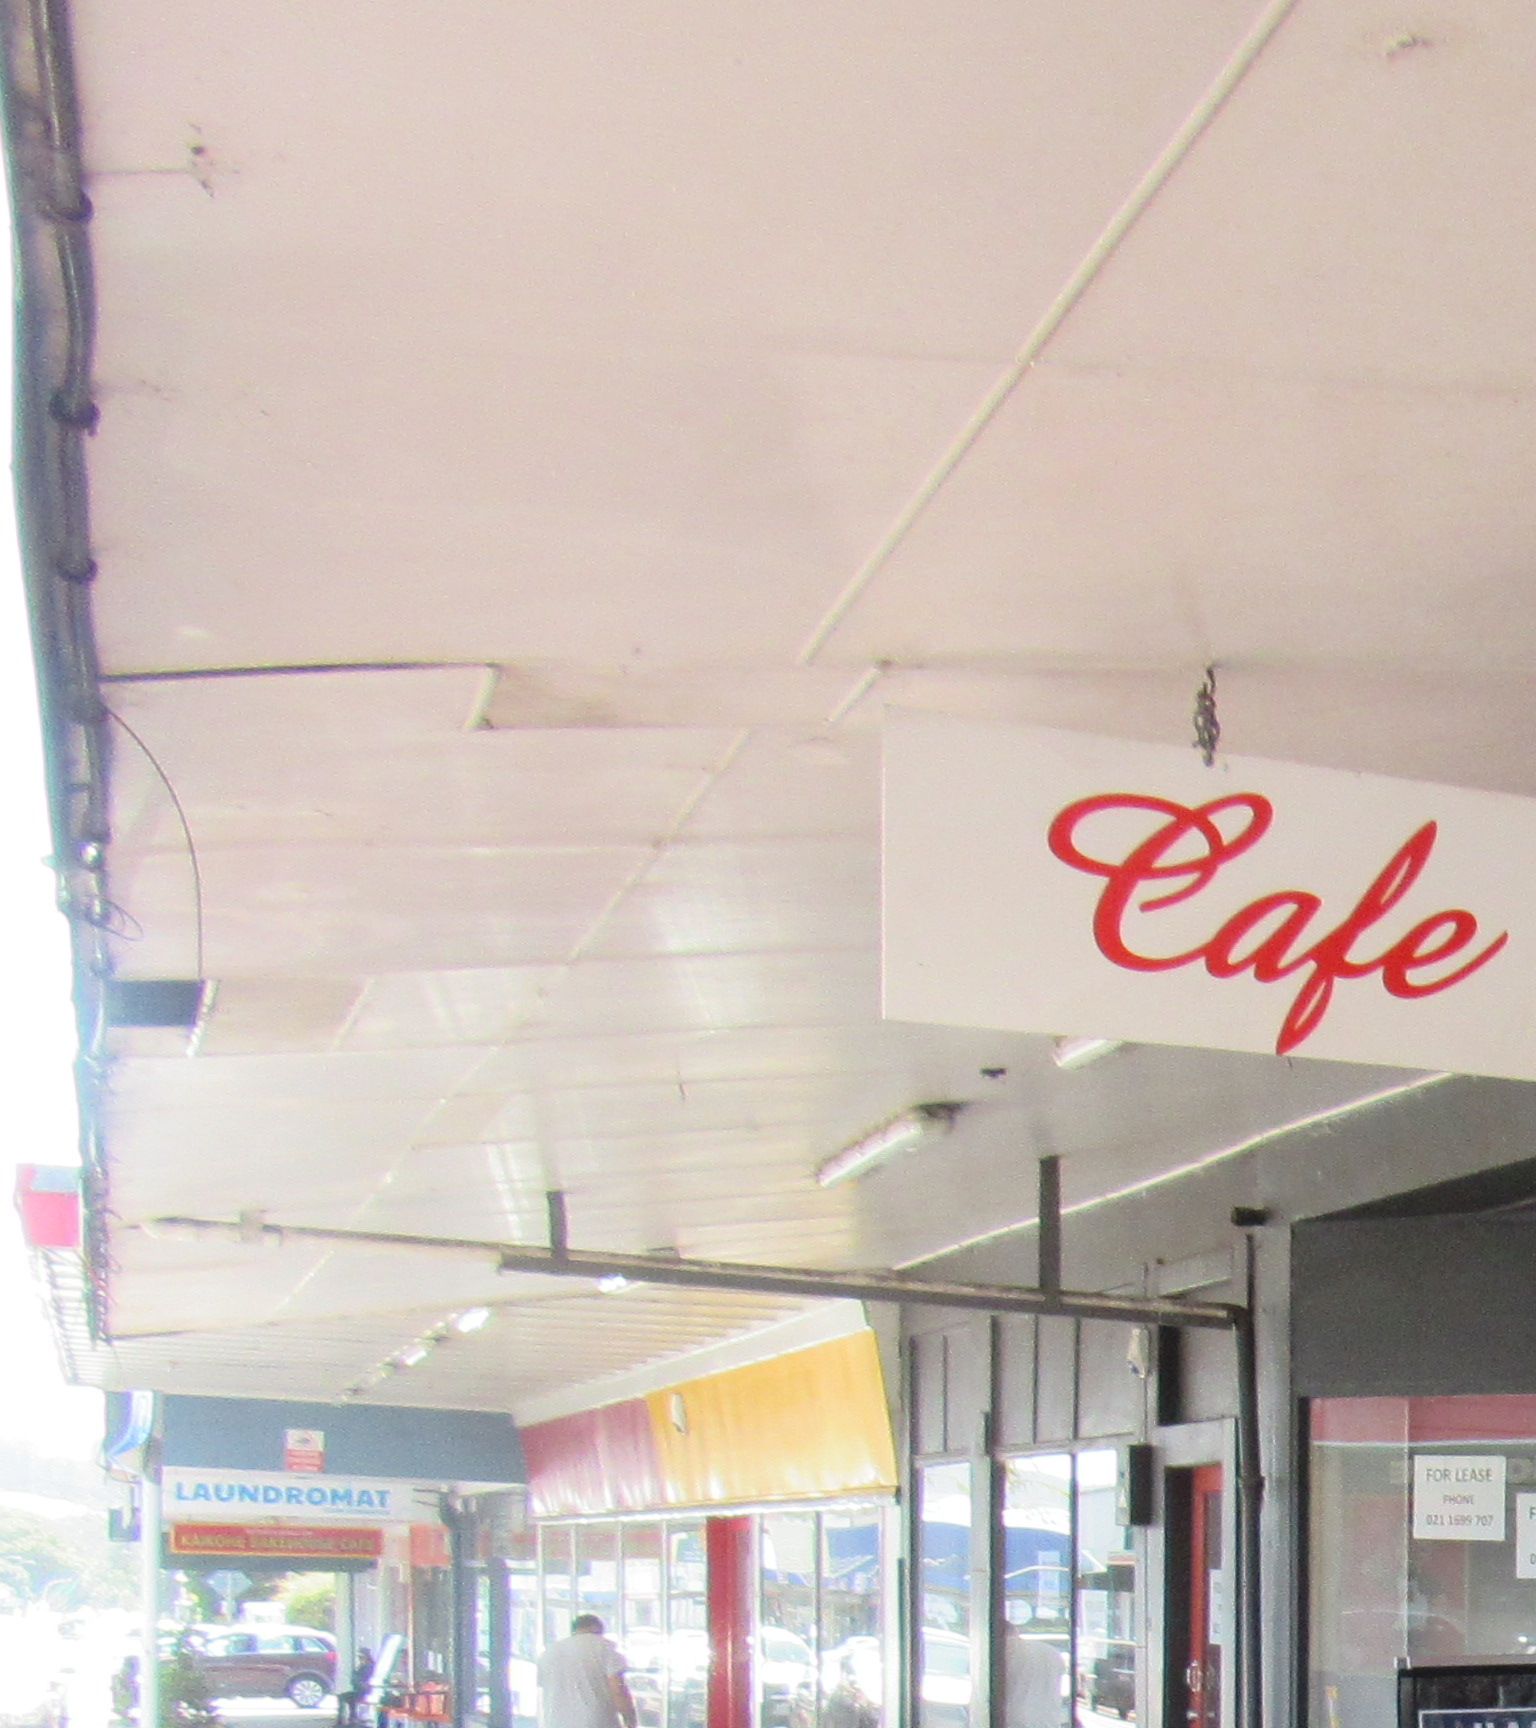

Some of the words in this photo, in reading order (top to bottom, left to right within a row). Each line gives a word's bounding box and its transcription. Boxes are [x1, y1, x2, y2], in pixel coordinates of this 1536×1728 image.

[1047, 792, 1507, 1056] Cafe
[1426, 1468, 1450, 1483] FOR
[1455, 1468, 1493, 1483] LEASE
[176, 1482, 391, 1508] LAUNDROMAT
[1443, 1494, 1475, 1505] PHONE
[1426, 1514, 1445, 1526] 021
